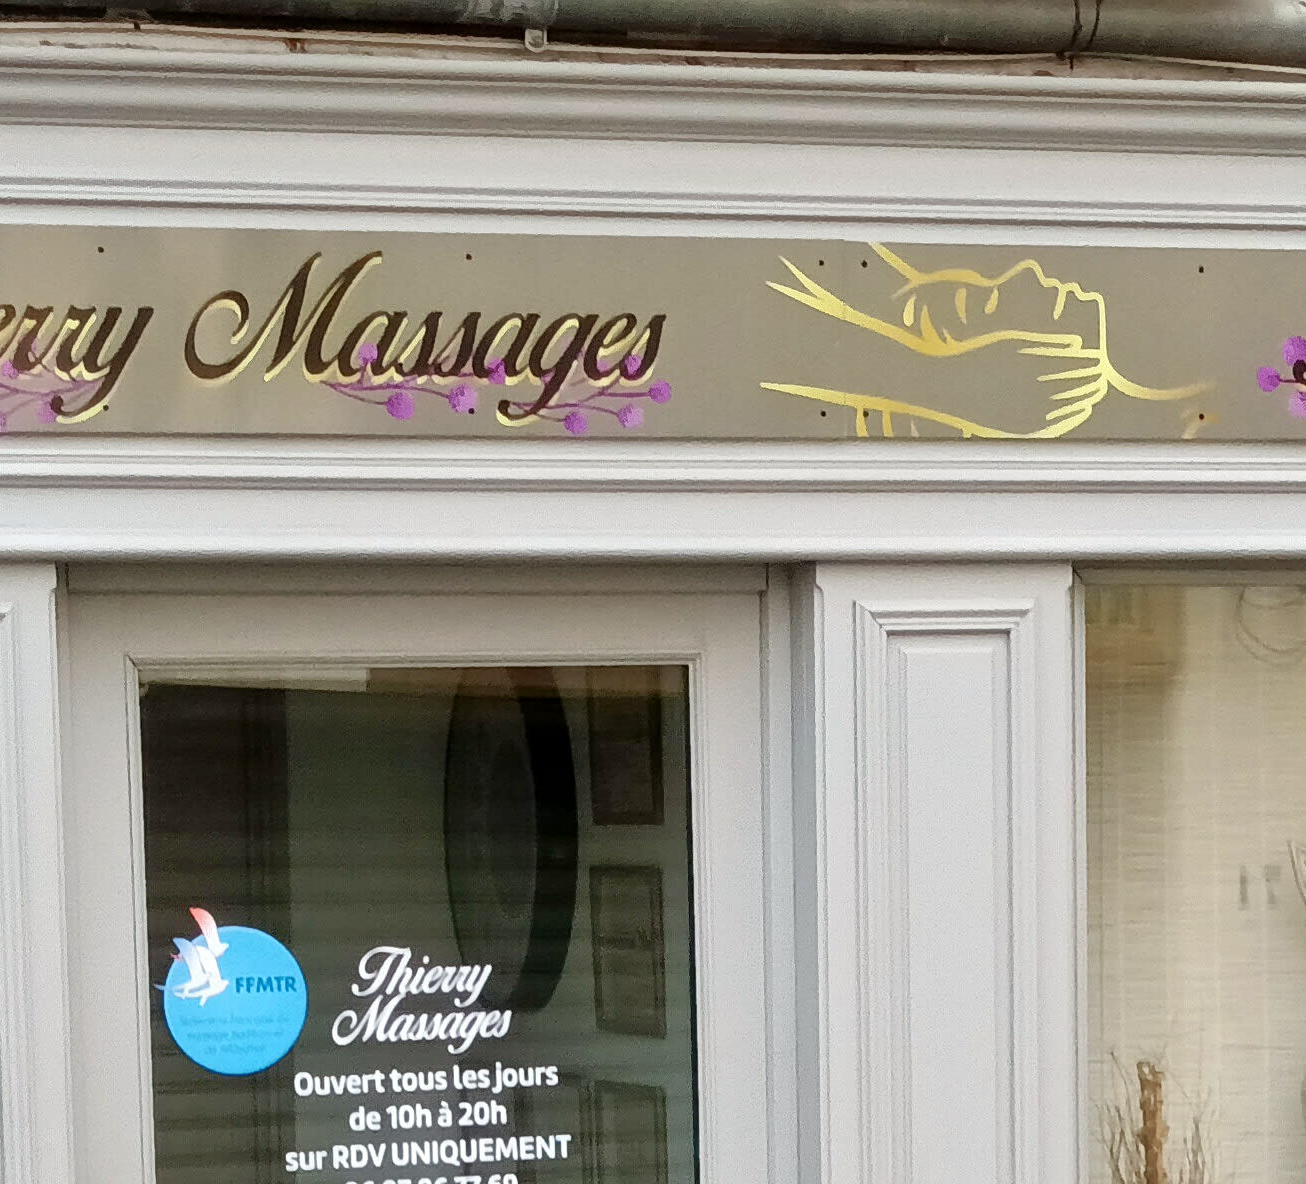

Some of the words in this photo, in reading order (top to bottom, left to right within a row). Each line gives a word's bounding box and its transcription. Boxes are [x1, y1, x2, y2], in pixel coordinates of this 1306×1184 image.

[183, 251, 668, 428] Massages
[235, 975, 297, 995] FFMTR
[351, 945, 492, 1007] Thierry
[331, 994, 512, 1055] Massages
[294, 1069, 385, 1097] Ouvert
[389, 1069, 448, 1093] tous
[453, 1064, 490, 1090] les
[491, 1061, 559, 1094] jours
[349, 1105, 382, 1132] de
[386, 1103, 432, 1129] 10h
[437, 1100, 453, 1128] à
[458, 1100, 508, 1126] 20h
[285, 1150, 328, 1172] sur
[332, 1143, 387, 1170] RDV
[391, 1134, 573, 1168] UNIQUEMENT
